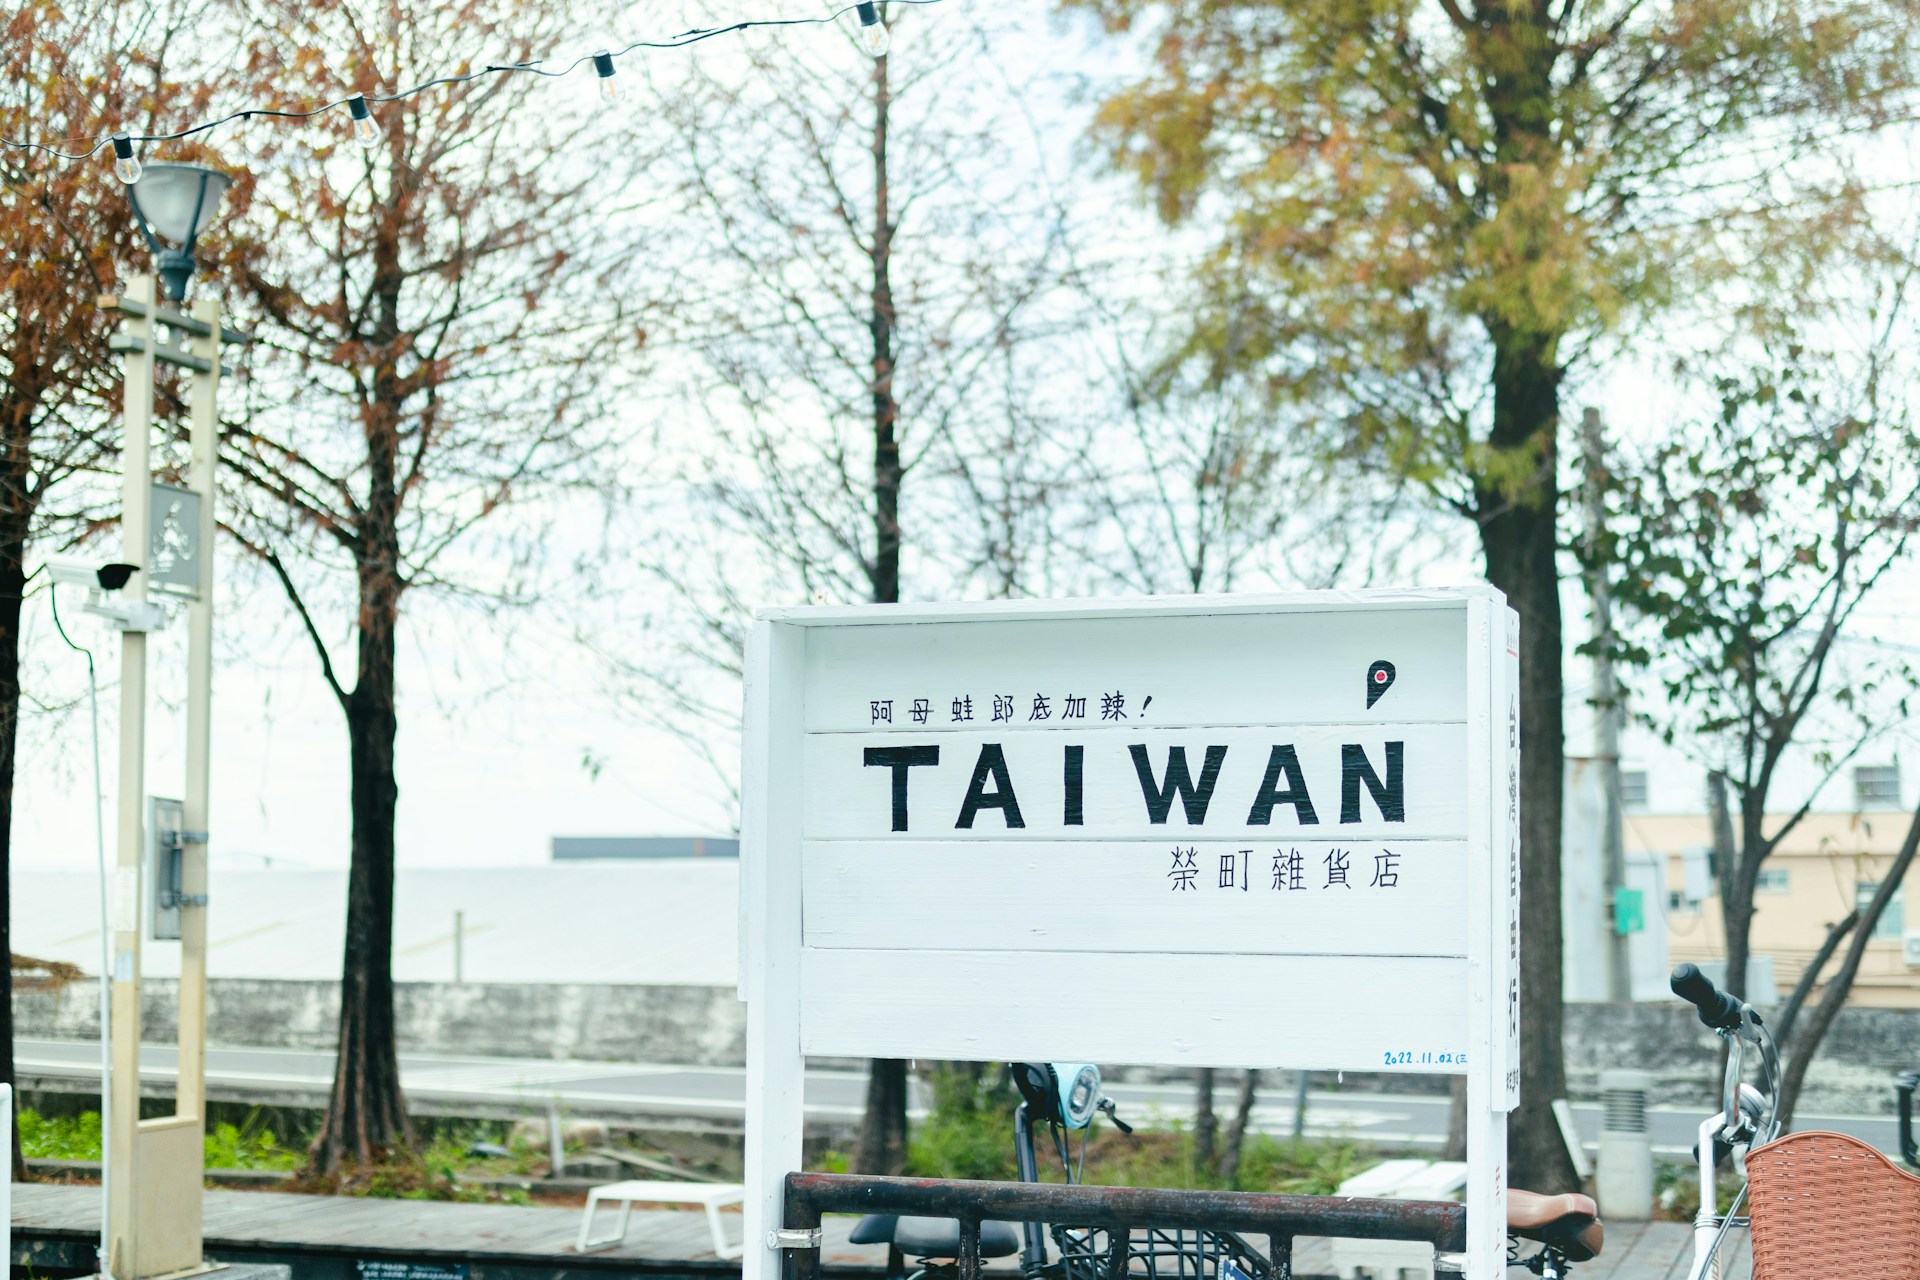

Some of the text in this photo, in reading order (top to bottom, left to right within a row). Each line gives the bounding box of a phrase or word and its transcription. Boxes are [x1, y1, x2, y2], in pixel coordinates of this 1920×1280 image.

[863, 741, 1406, 832] TAIWAN
[1167, 846, 1402, 892] 榮町雜貨店
